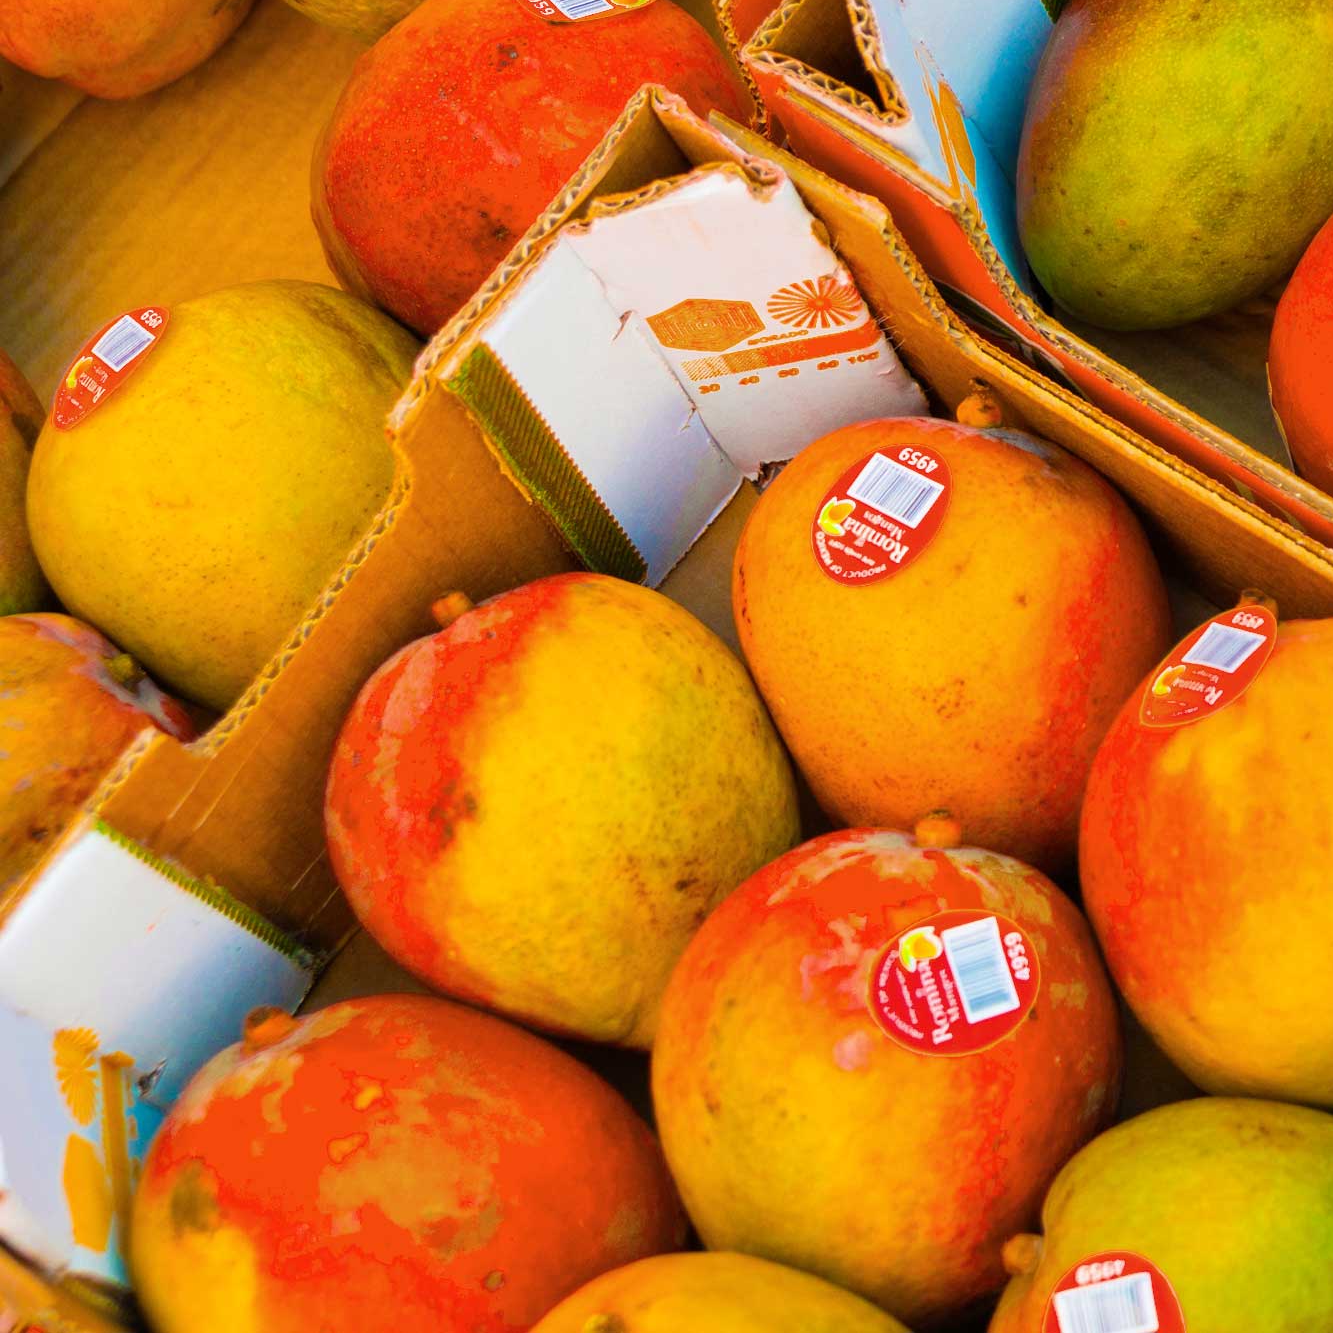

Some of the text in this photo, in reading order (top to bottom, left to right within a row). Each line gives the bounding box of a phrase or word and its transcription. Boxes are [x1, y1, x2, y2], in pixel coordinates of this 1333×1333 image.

[847, 351, 880, 364] 100
[898, 447, 938, 473] 4959
[843, 517, 909, 564] Romina
[863, 511, 906, 541] Mangos
[815, 531, 886, 578] PRODUCT OF MEXICO
[1004, 932, 1030, 980] 4959
[917, 959, 953, 1045] Romina
